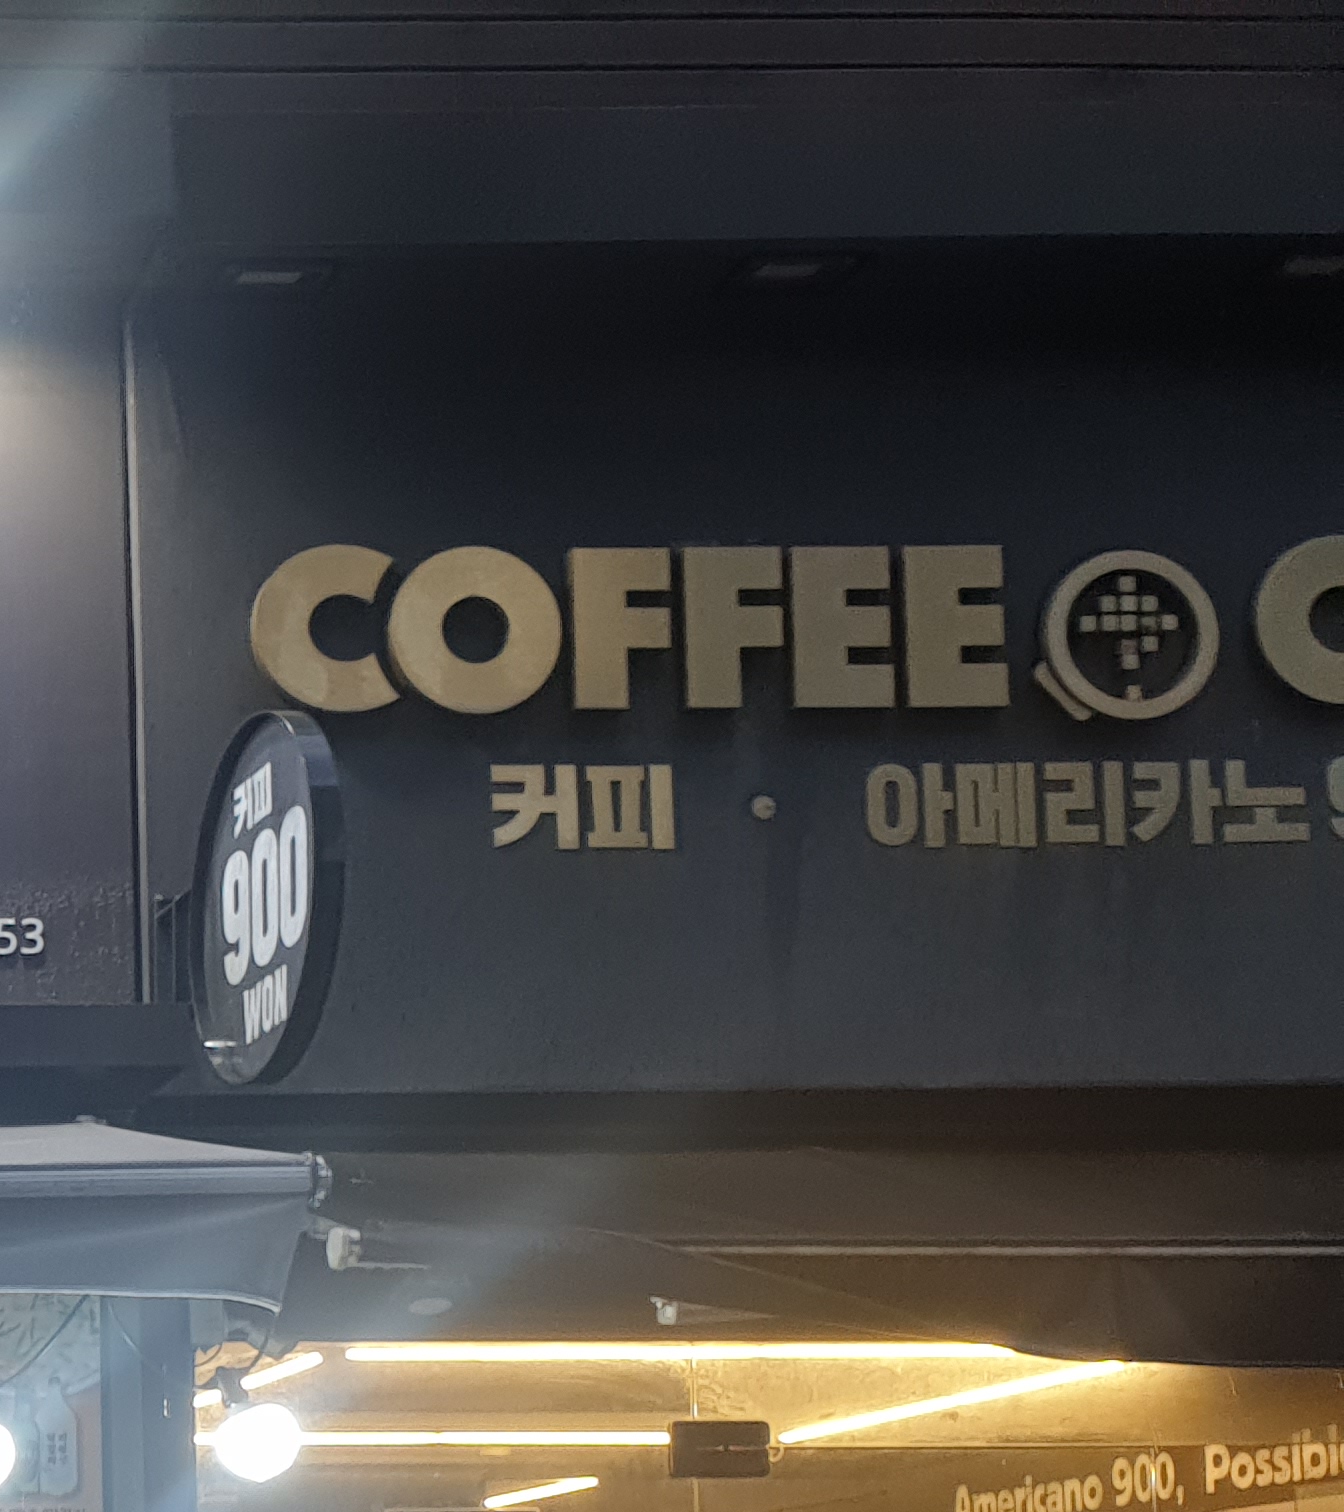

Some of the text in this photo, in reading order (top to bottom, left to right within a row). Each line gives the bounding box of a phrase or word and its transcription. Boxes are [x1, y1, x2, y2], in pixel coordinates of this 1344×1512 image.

[249, 542, 1010, 714] COFFEE
[232, 762, 273, 831] 커피
[489, 761, 675, 851] 커피
[864, 758, 1310, 848] 아메리카노
[221, 804, 309, 987] 900
[241, 964, 289, 1047] WON
[1111, 1450, 1185, 1506] 900,
[1204, 1422, 1344, 1495] Possibi
